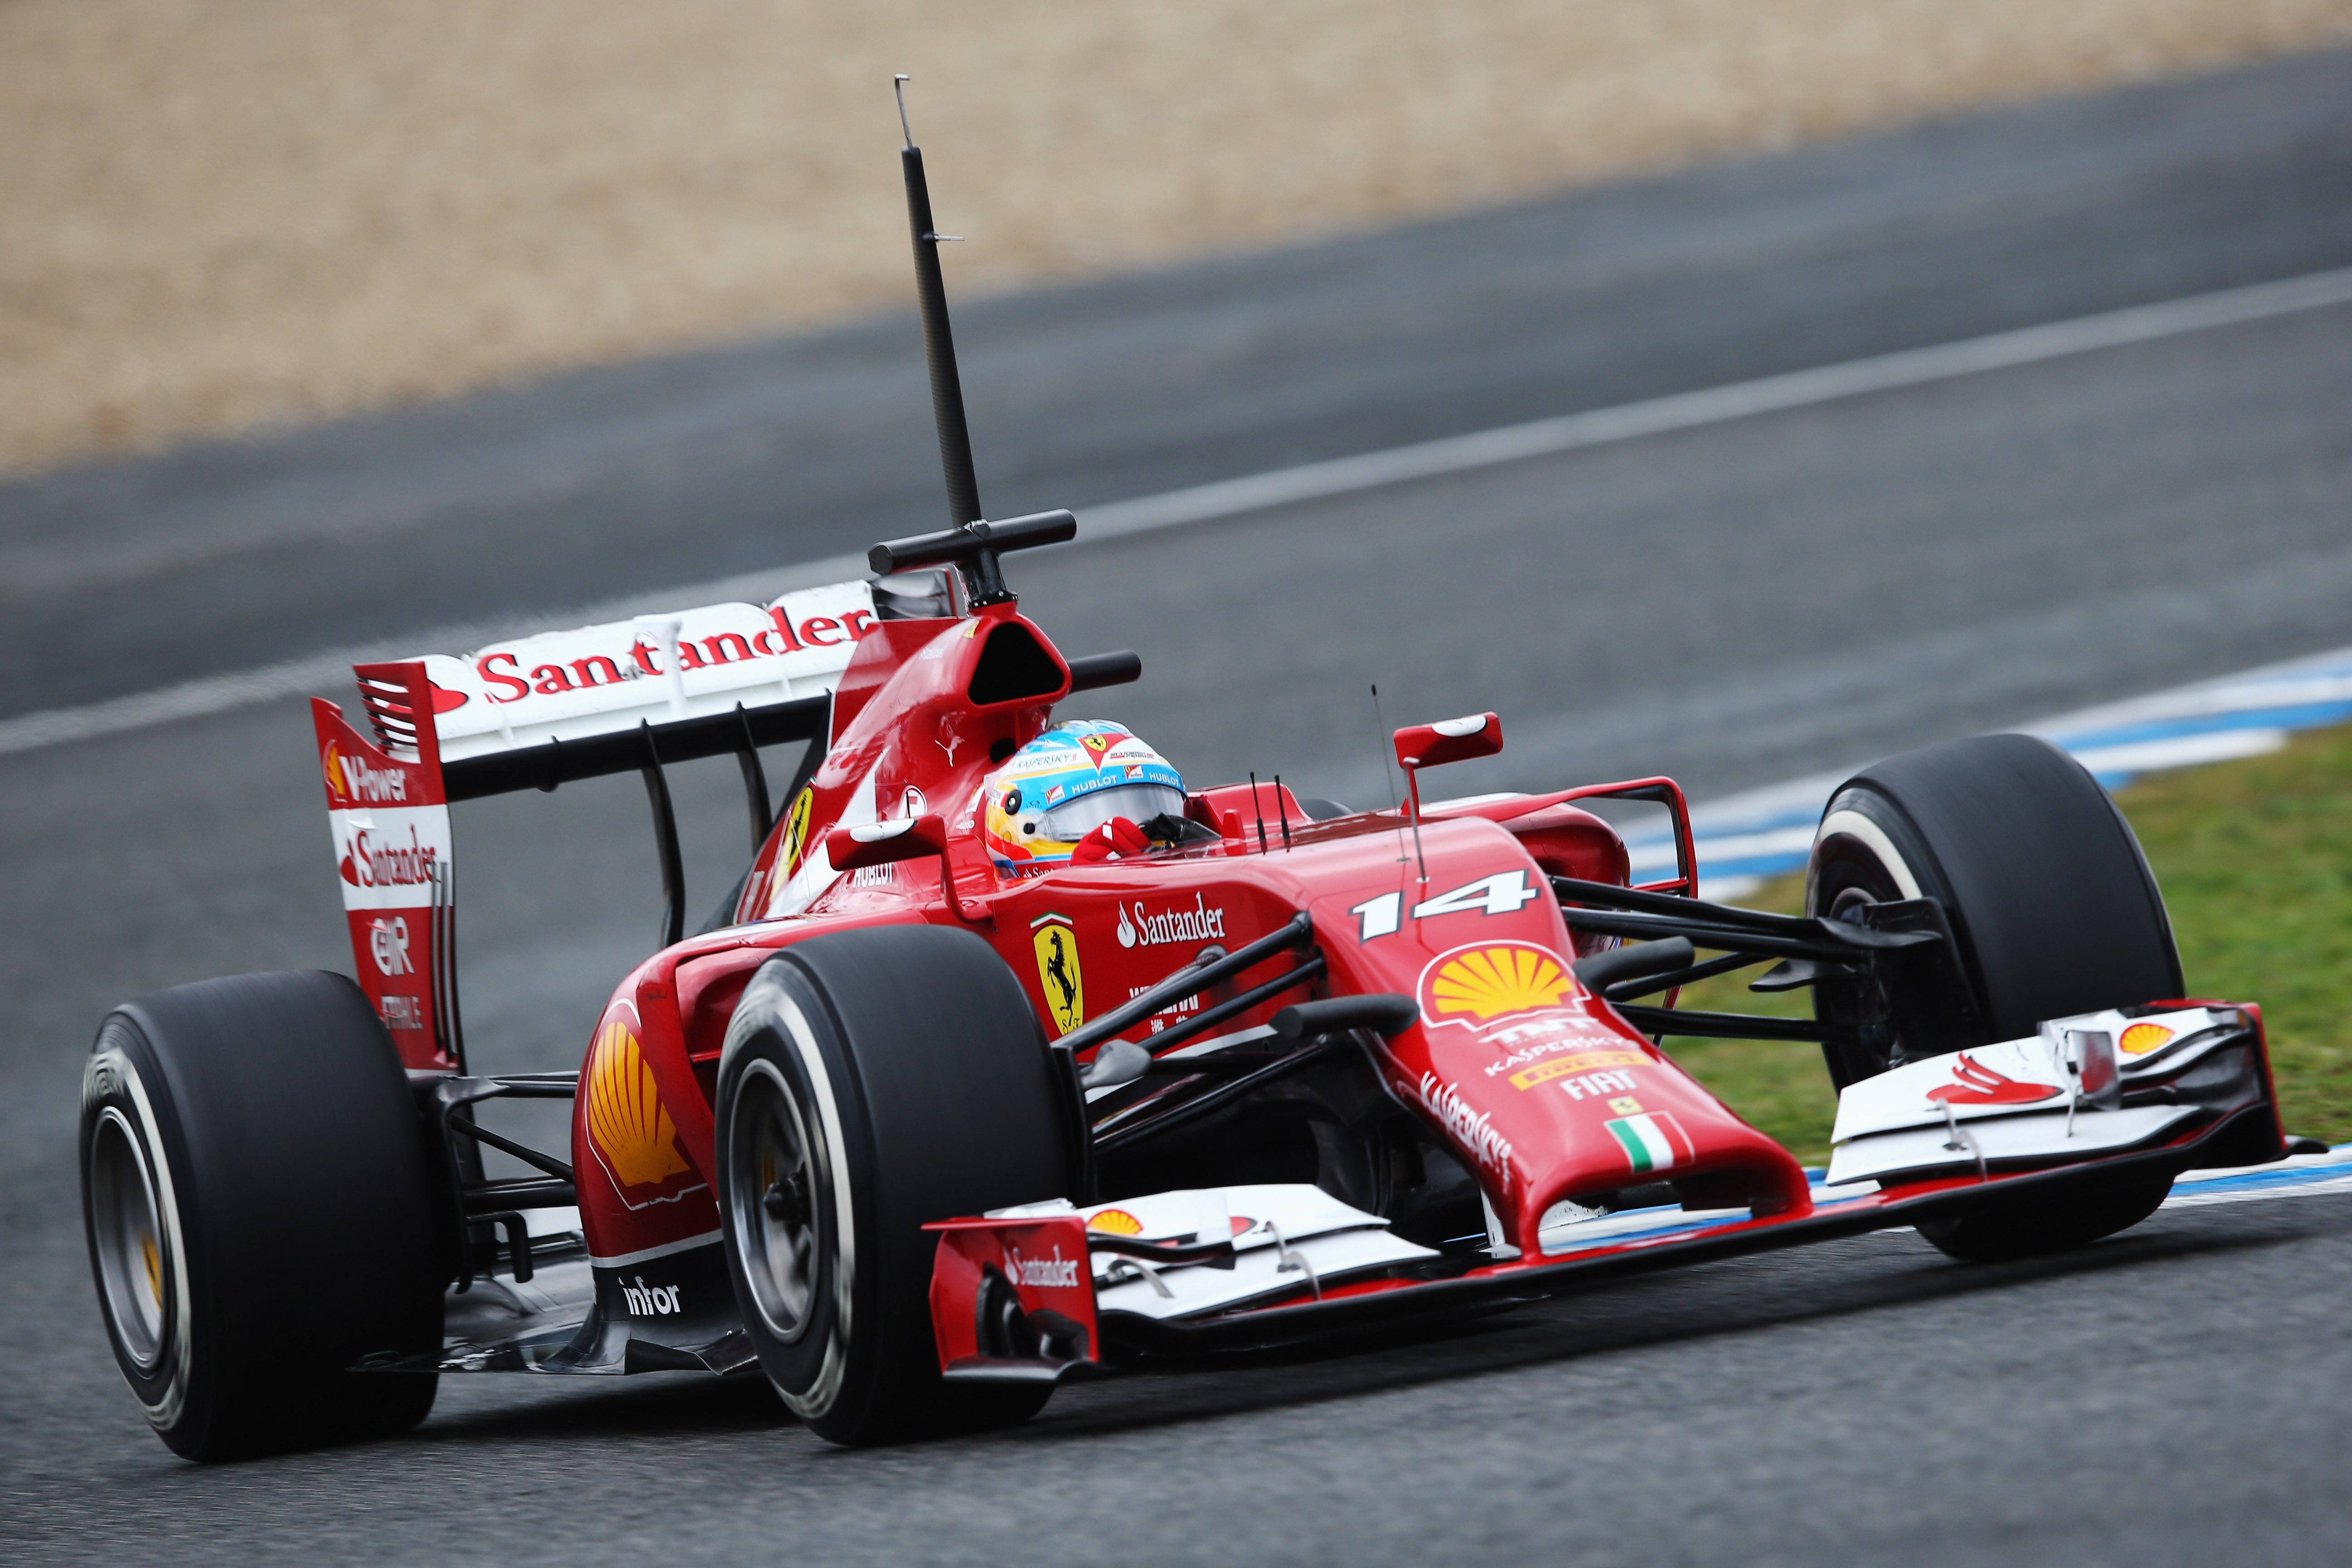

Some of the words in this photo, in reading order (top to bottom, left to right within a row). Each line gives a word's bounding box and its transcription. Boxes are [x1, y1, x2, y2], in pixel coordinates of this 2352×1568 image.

[477, 606, 871, 703] Santander
[1071, 774, 1117, 794] HUBLOT
[1149, 771, 1179, 787] HUBLOT
[1134, 891, 1225, 946] Santander
[1348, 869, 1541, 946] 14
[1477, 1017, 1599, 1044] TNT
[1484, 1036, 1627, 1077] KASPERSKY
[1559, 1069, 1637, 1101] FIAT
[1420, 1070, 1505, 1167] KASPERSKY
[1012, 1244, 1079, 1287] Santander
[618, 1276, 681, 1315] infor
